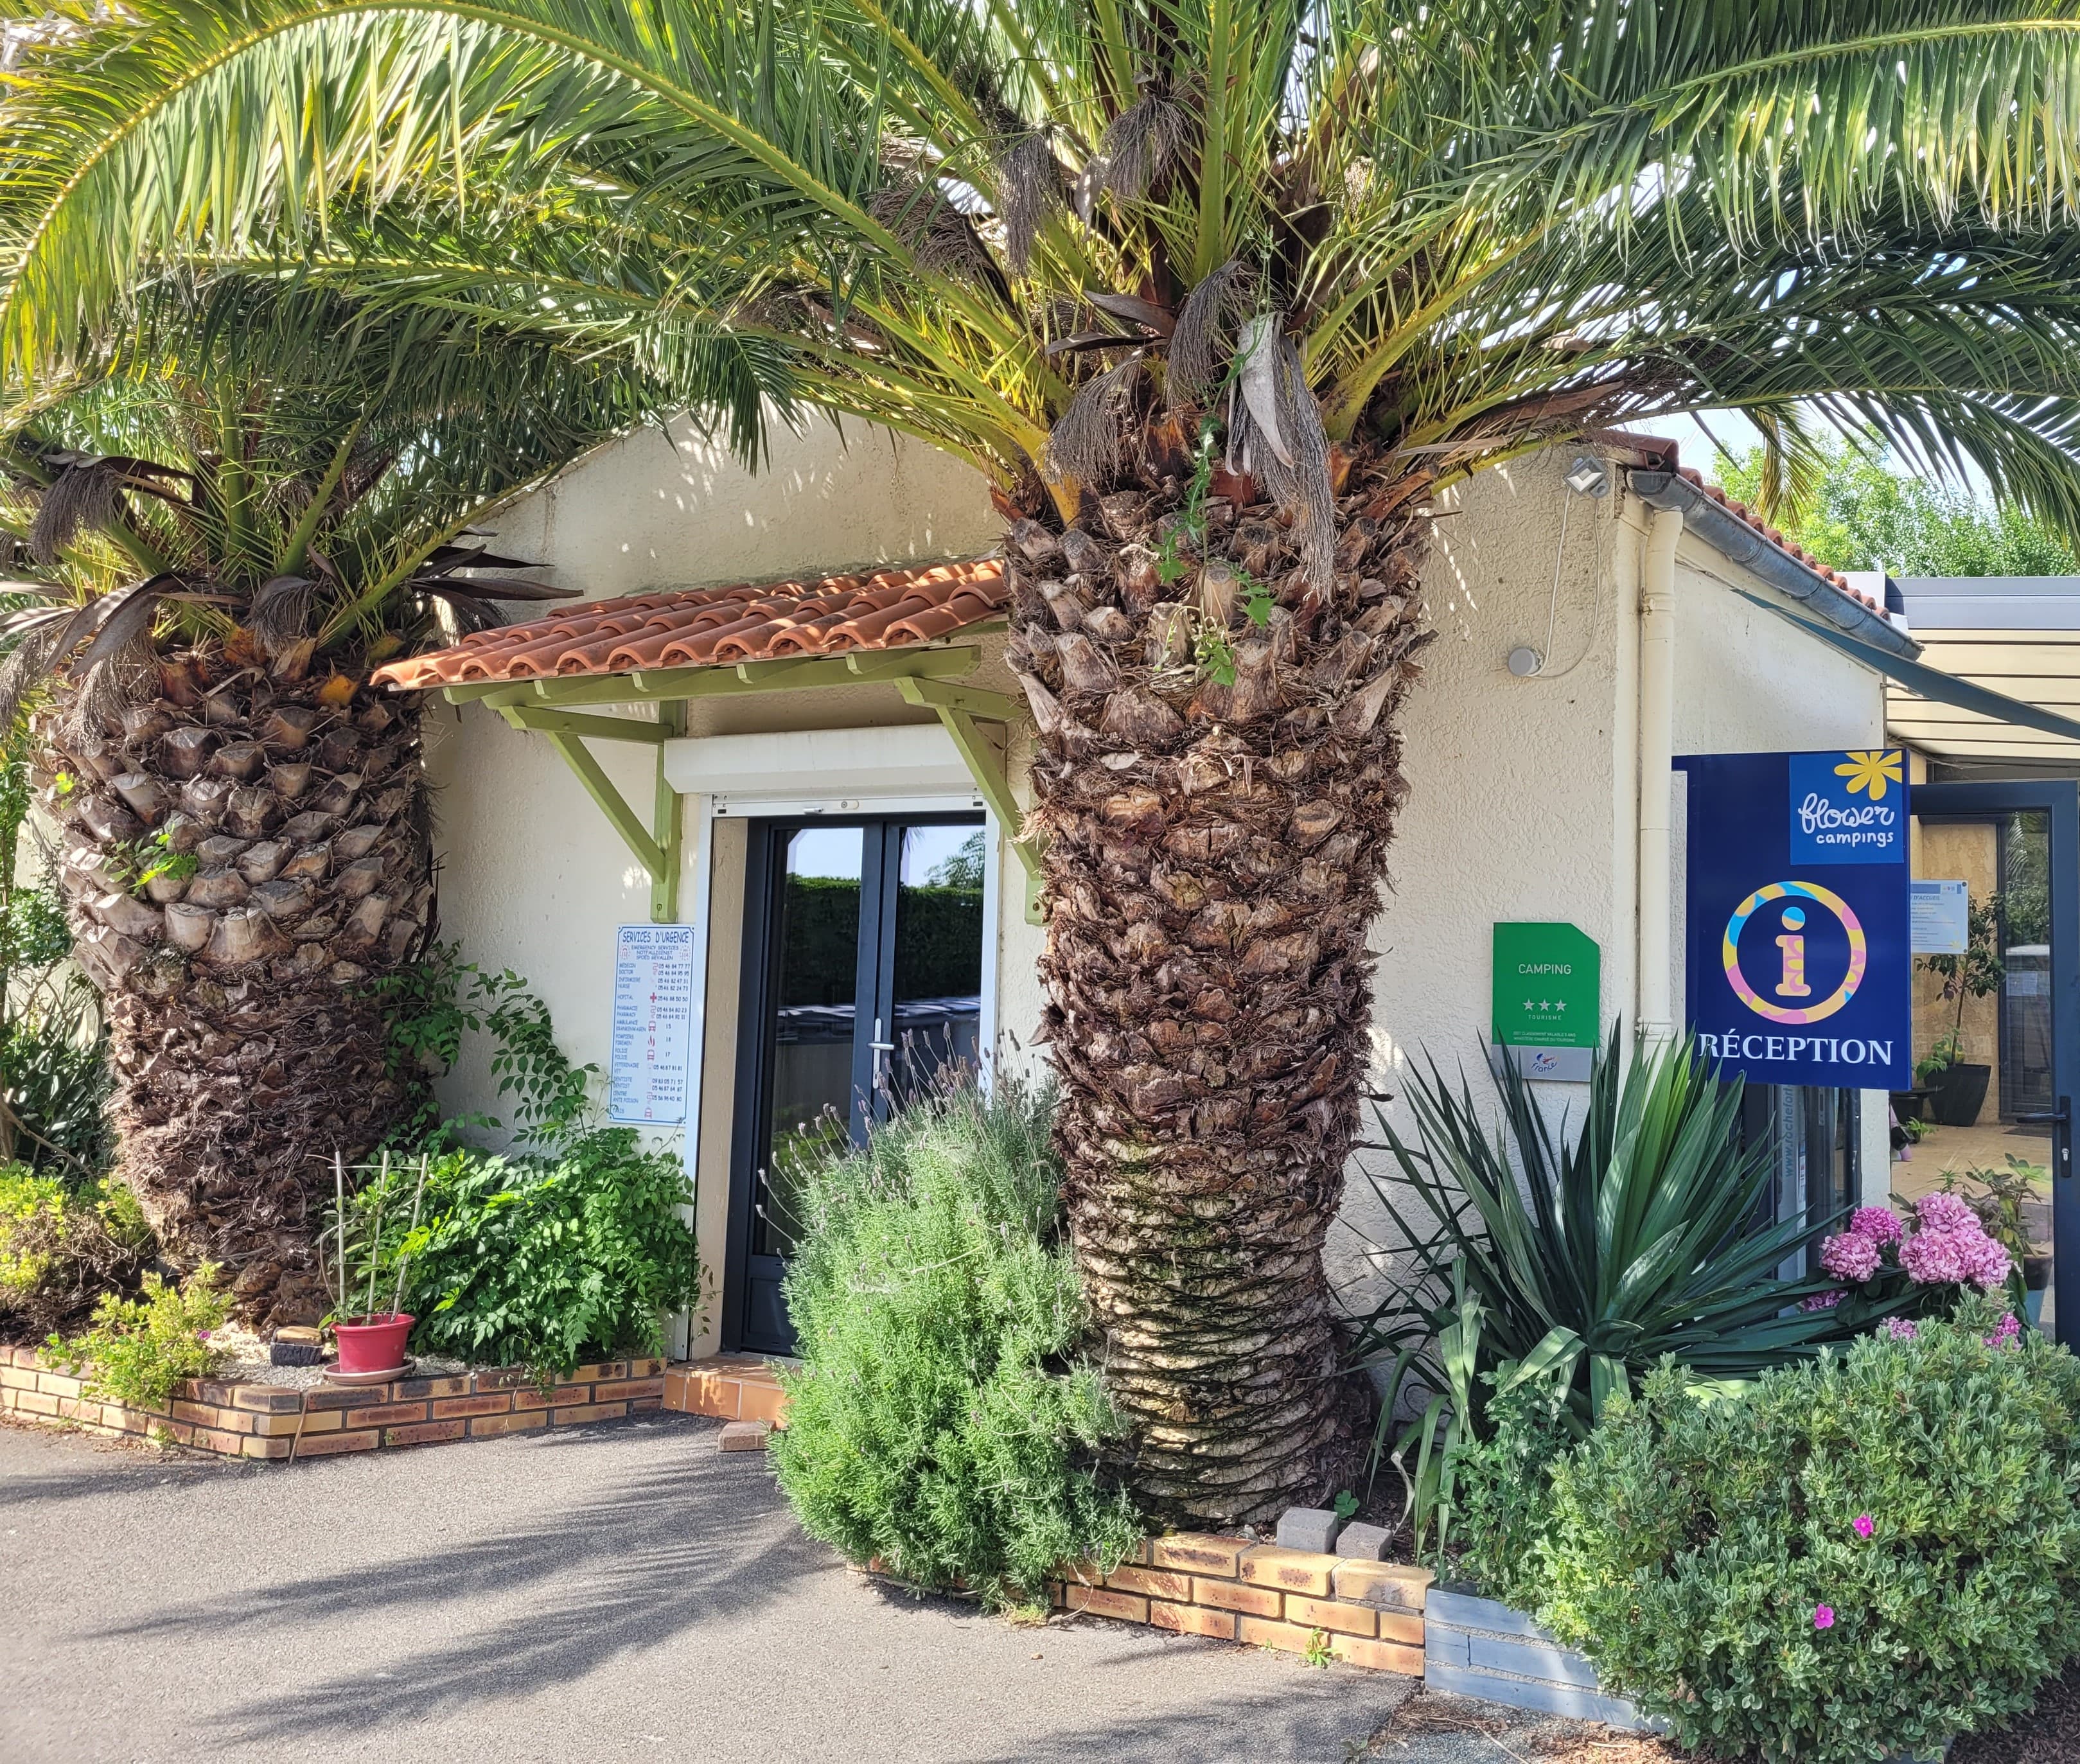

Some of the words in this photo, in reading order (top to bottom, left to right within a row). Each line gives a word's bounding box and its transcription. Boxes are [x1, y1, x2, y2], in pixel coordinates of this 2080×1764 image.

[1798, 793, 1894, 834] flower
[1816, 832, 1894, 847] campings
[622, 931, 651, 942] SERVICES
[655, 931, 689, 943] D'URGENCE
[1519, 964, 1571, 975] CAMPING
[1698, 1028, 1894, 1065] RÉCEPTION
[1531, 1061, 1557, 1072] France
